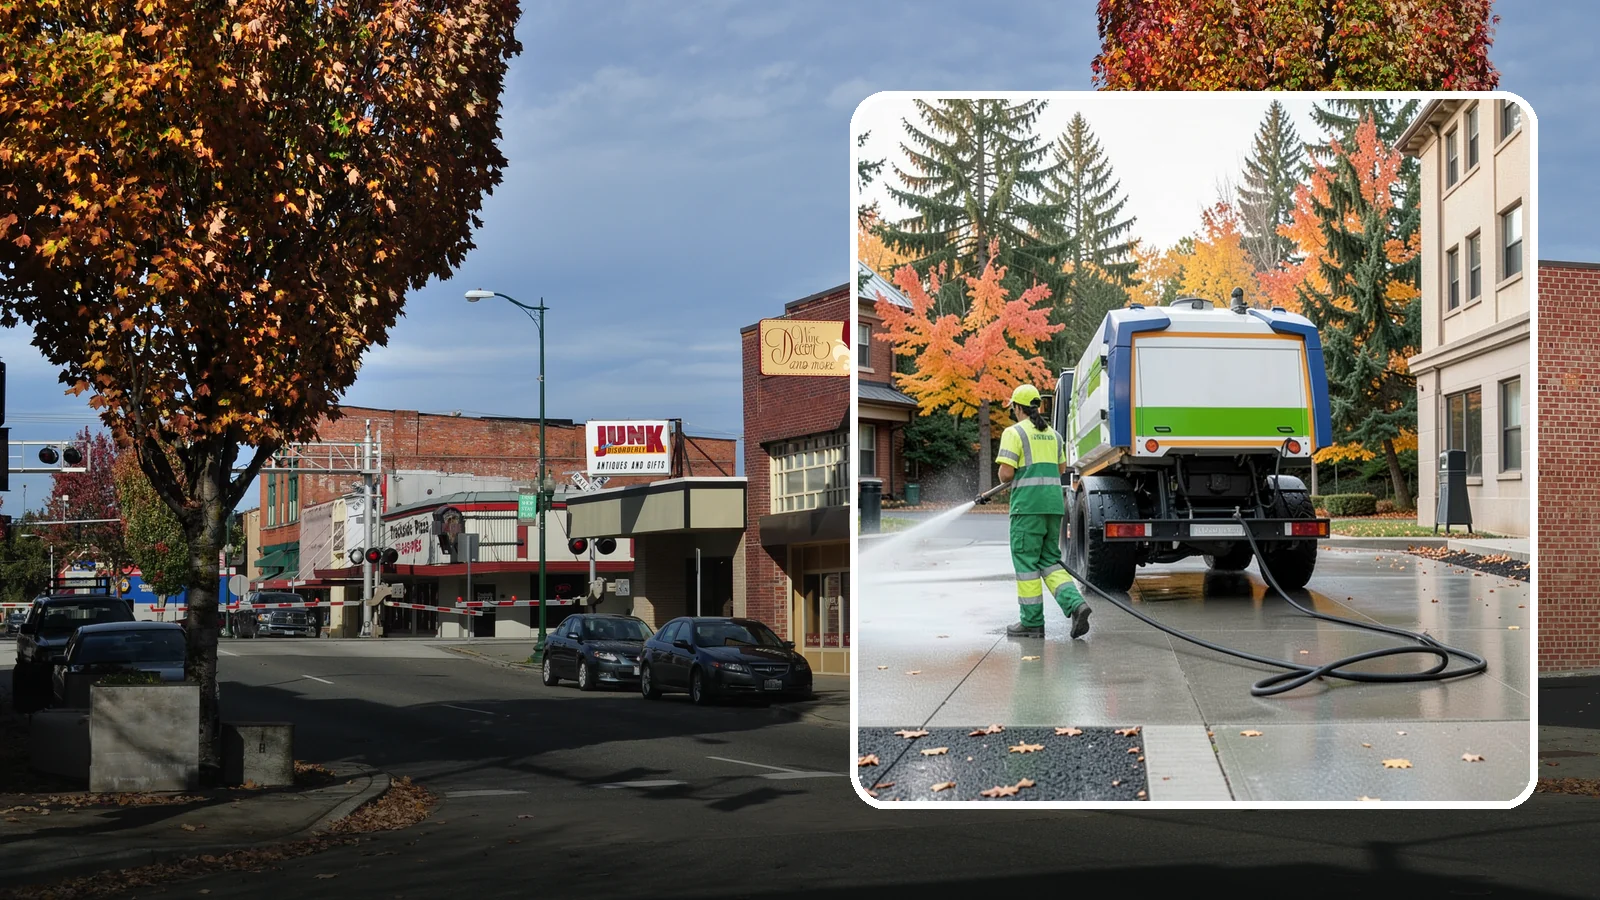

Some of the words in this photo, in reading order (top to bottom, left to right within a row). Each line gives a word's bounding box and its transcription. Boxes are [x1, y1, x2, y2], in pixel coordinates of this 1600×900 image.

[595, 425, 665, 457] JUNK
[607, 445, 646, 454] DISORDERLY
[596, 461, 628, 470] ANTIQUES
[631, 461, 644, 470] AND
[647, 460, 666, 470] GIFTS
[352, 498, 365, 511] CRO
[389, 521, 413, 540] Trackside
[414, 519, 429, 535] Pizza
